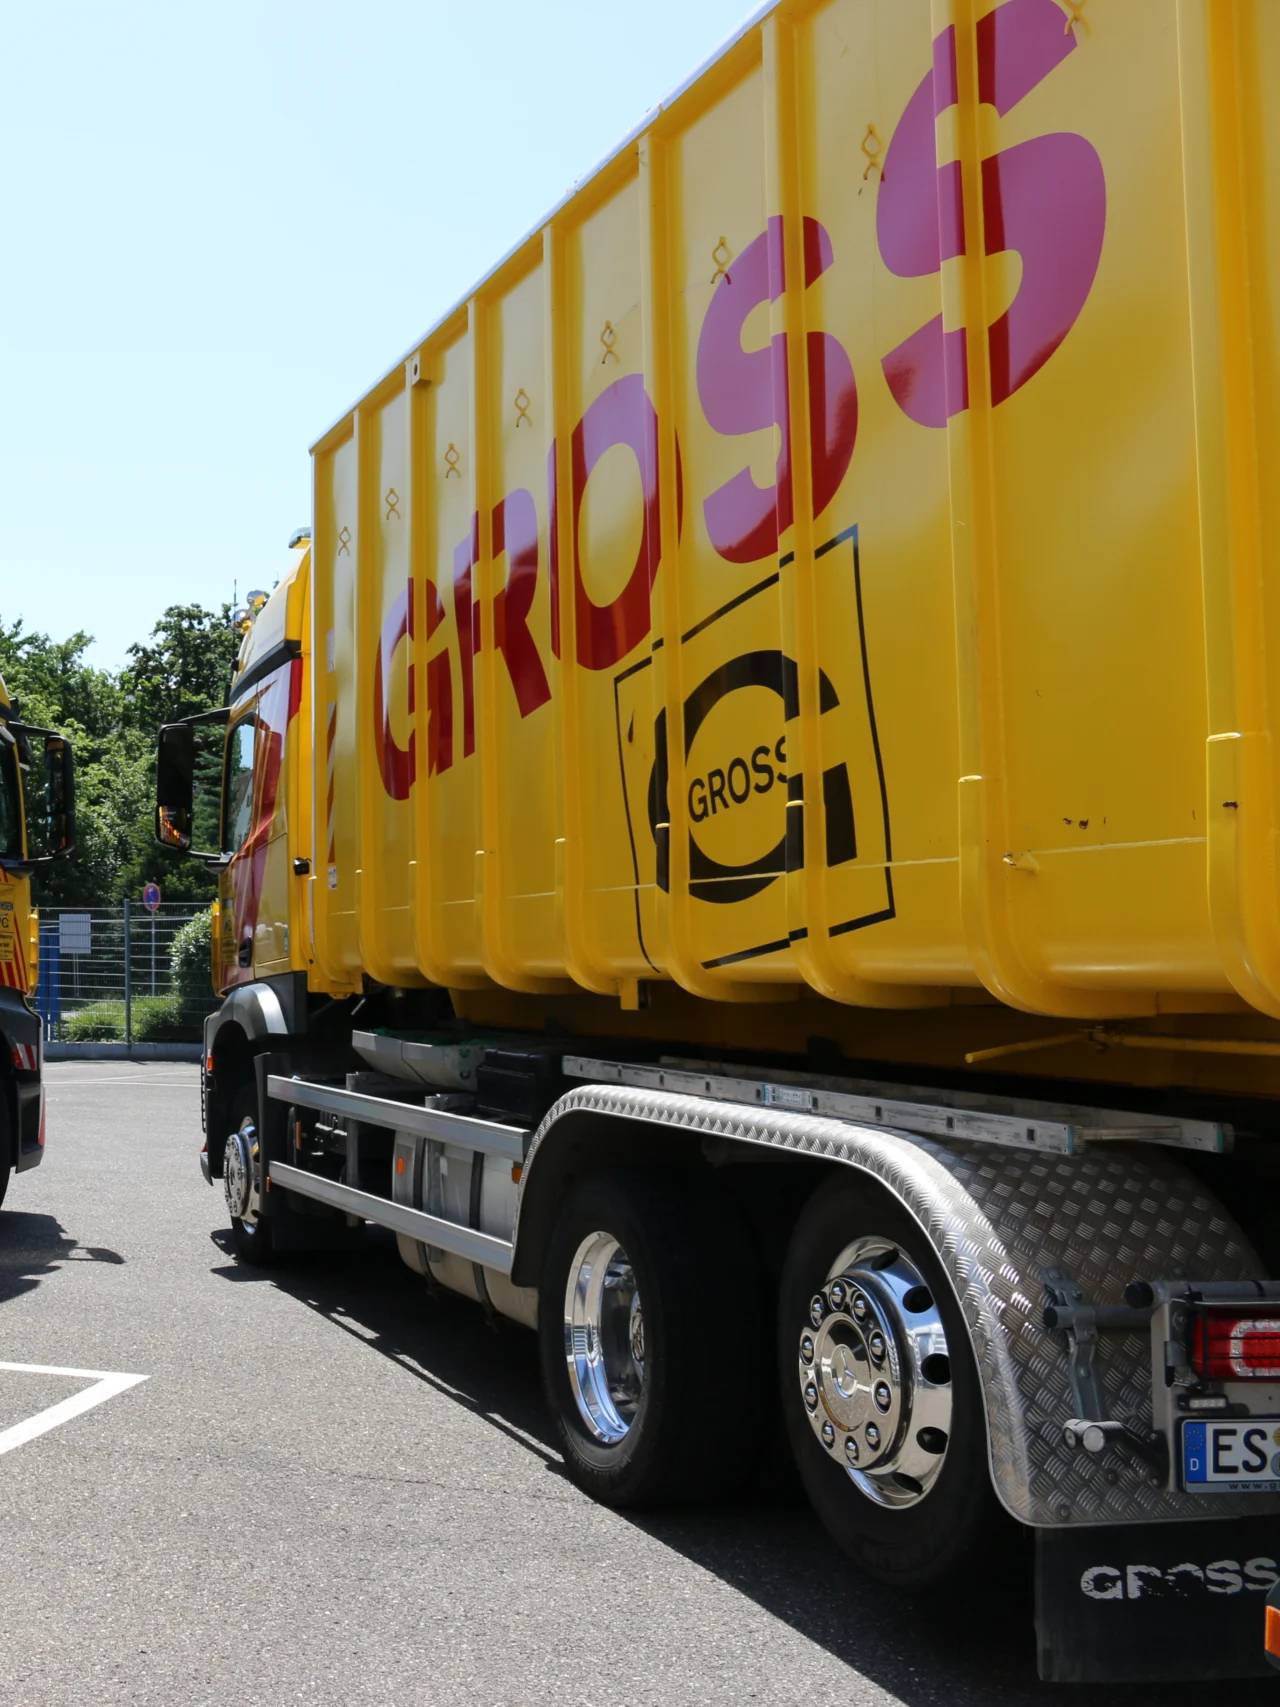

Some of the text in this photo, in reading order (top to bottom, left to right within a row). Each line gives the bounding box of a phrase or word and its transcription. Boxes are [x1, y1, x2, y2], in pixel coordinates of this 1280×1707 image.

[374, 0, 1107, 801] GROSS
[1189, 1457, 1200, 1471] D
[1212, 1428, 1268, 1474] ES
[1229, 1482, 1280, 1491] www.g
